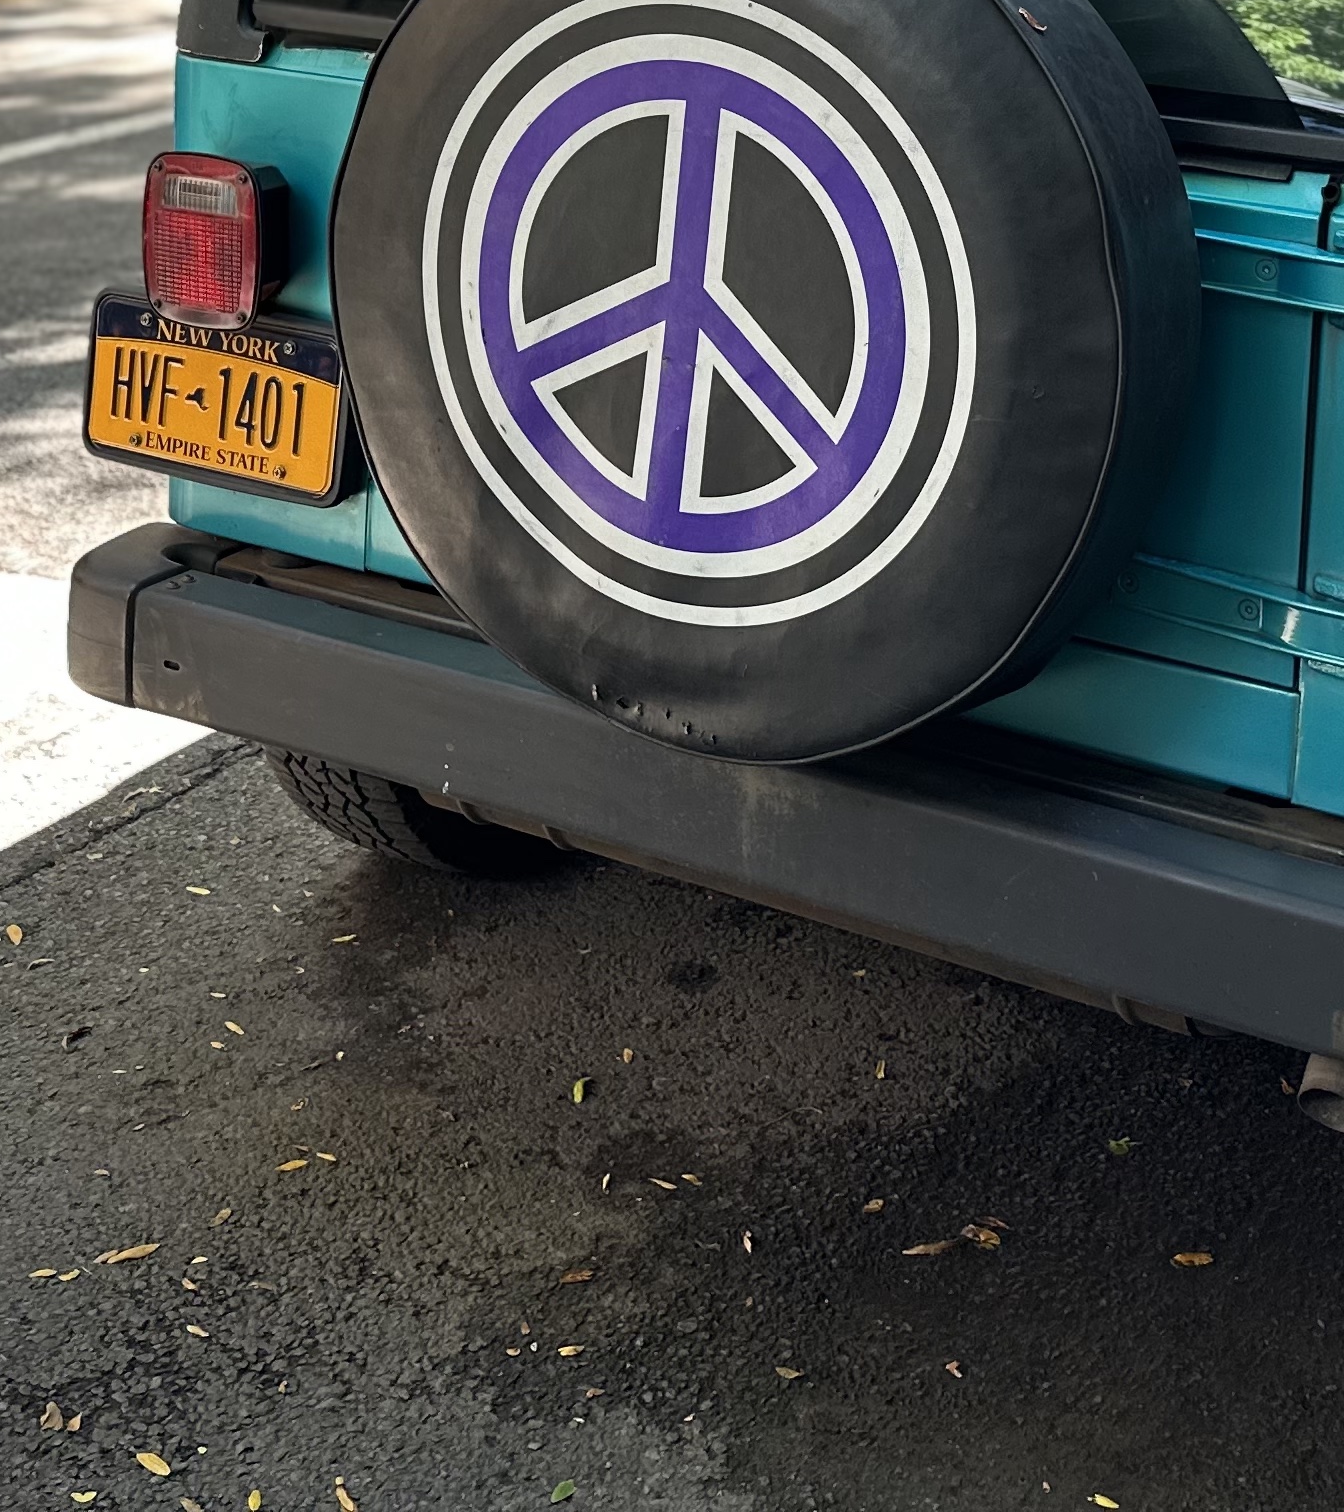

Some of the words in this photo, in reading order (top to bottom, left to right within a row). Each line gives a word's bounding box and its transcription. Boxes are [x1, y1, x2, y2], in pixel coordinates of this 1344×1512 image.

[156, 318, 212, 347] NEW
[219, 331, 280, 363] YORK
[110, 345, 185, 428] HVF
[217, 365, 306, 457] 1401
[146, 431, 210, 461] EMPIRE
[216, 449, 269, 474] STATE
